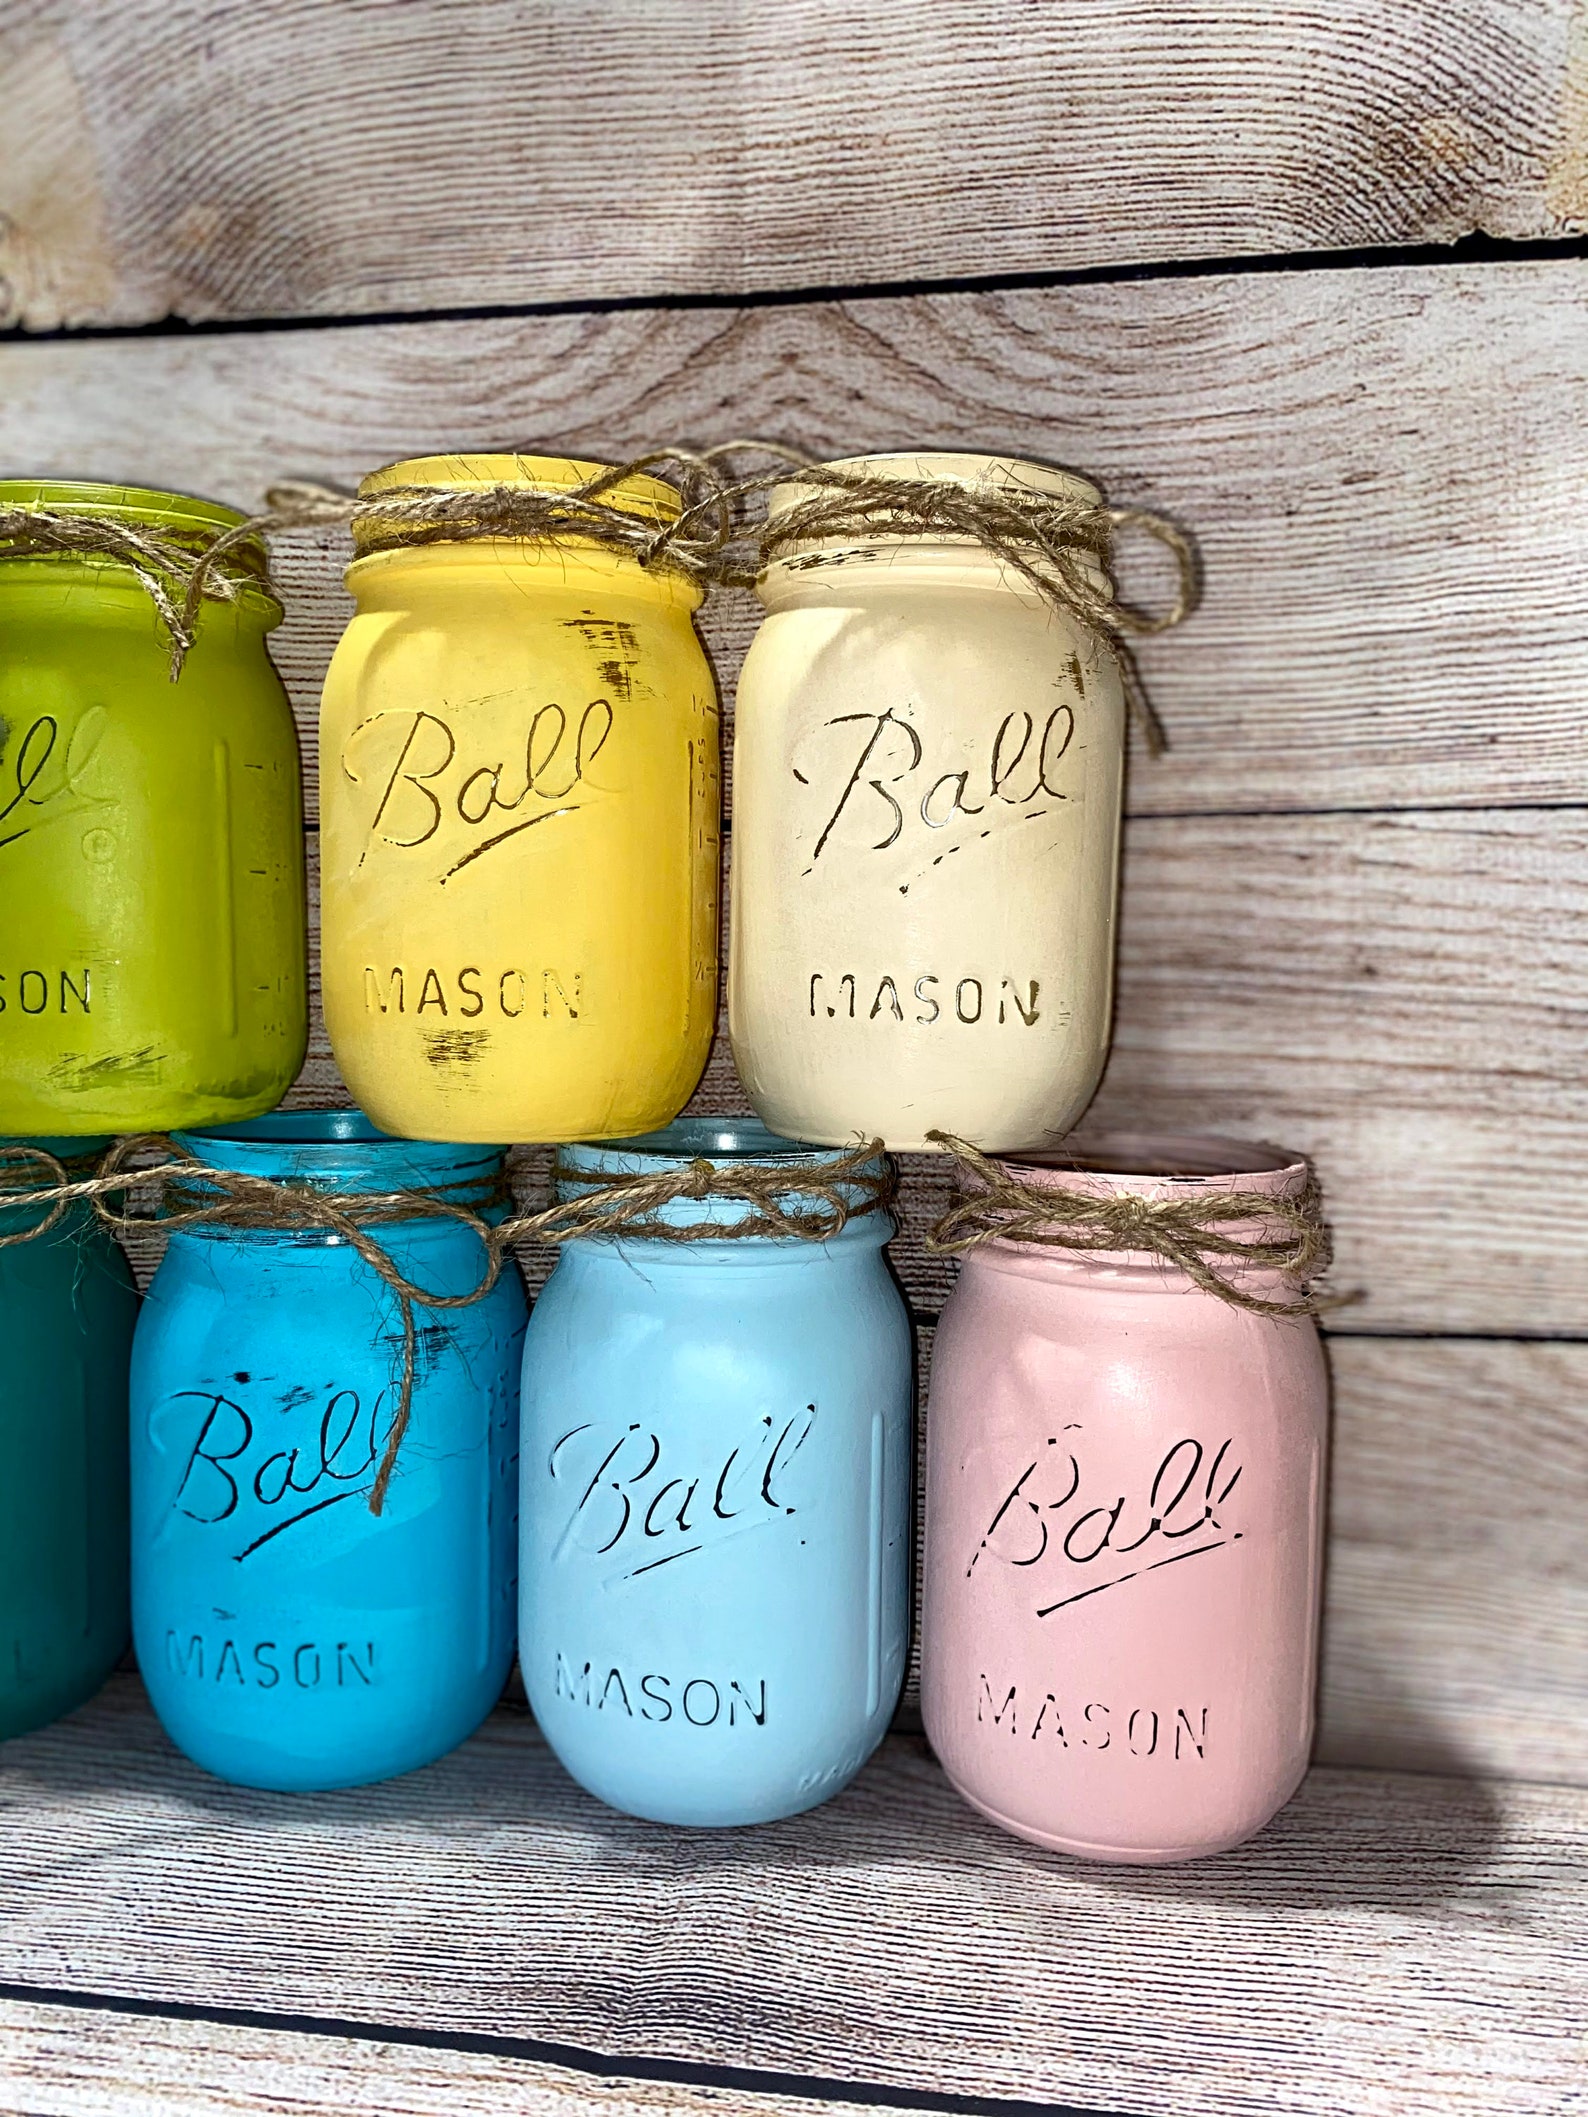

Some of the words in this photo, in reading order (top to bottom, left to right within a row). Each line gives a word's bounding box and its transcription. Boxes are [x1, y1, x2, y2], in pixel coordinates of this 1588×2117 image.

[342, 698, 626, 878] Ball
[792, 704, 1075, 877] Ball
[364, 965, 581, 1019] MASON
[810, 973, 1040, 1027] MASON
[549, 1403, 817, 1560] Ball
[966, 1423, 1243, 1578] Ball
[166, 1629, 374, 1689] MASON
[556, 1652, 766, 1727] MASON
[978, 1674, 1208, 1760] MASON
